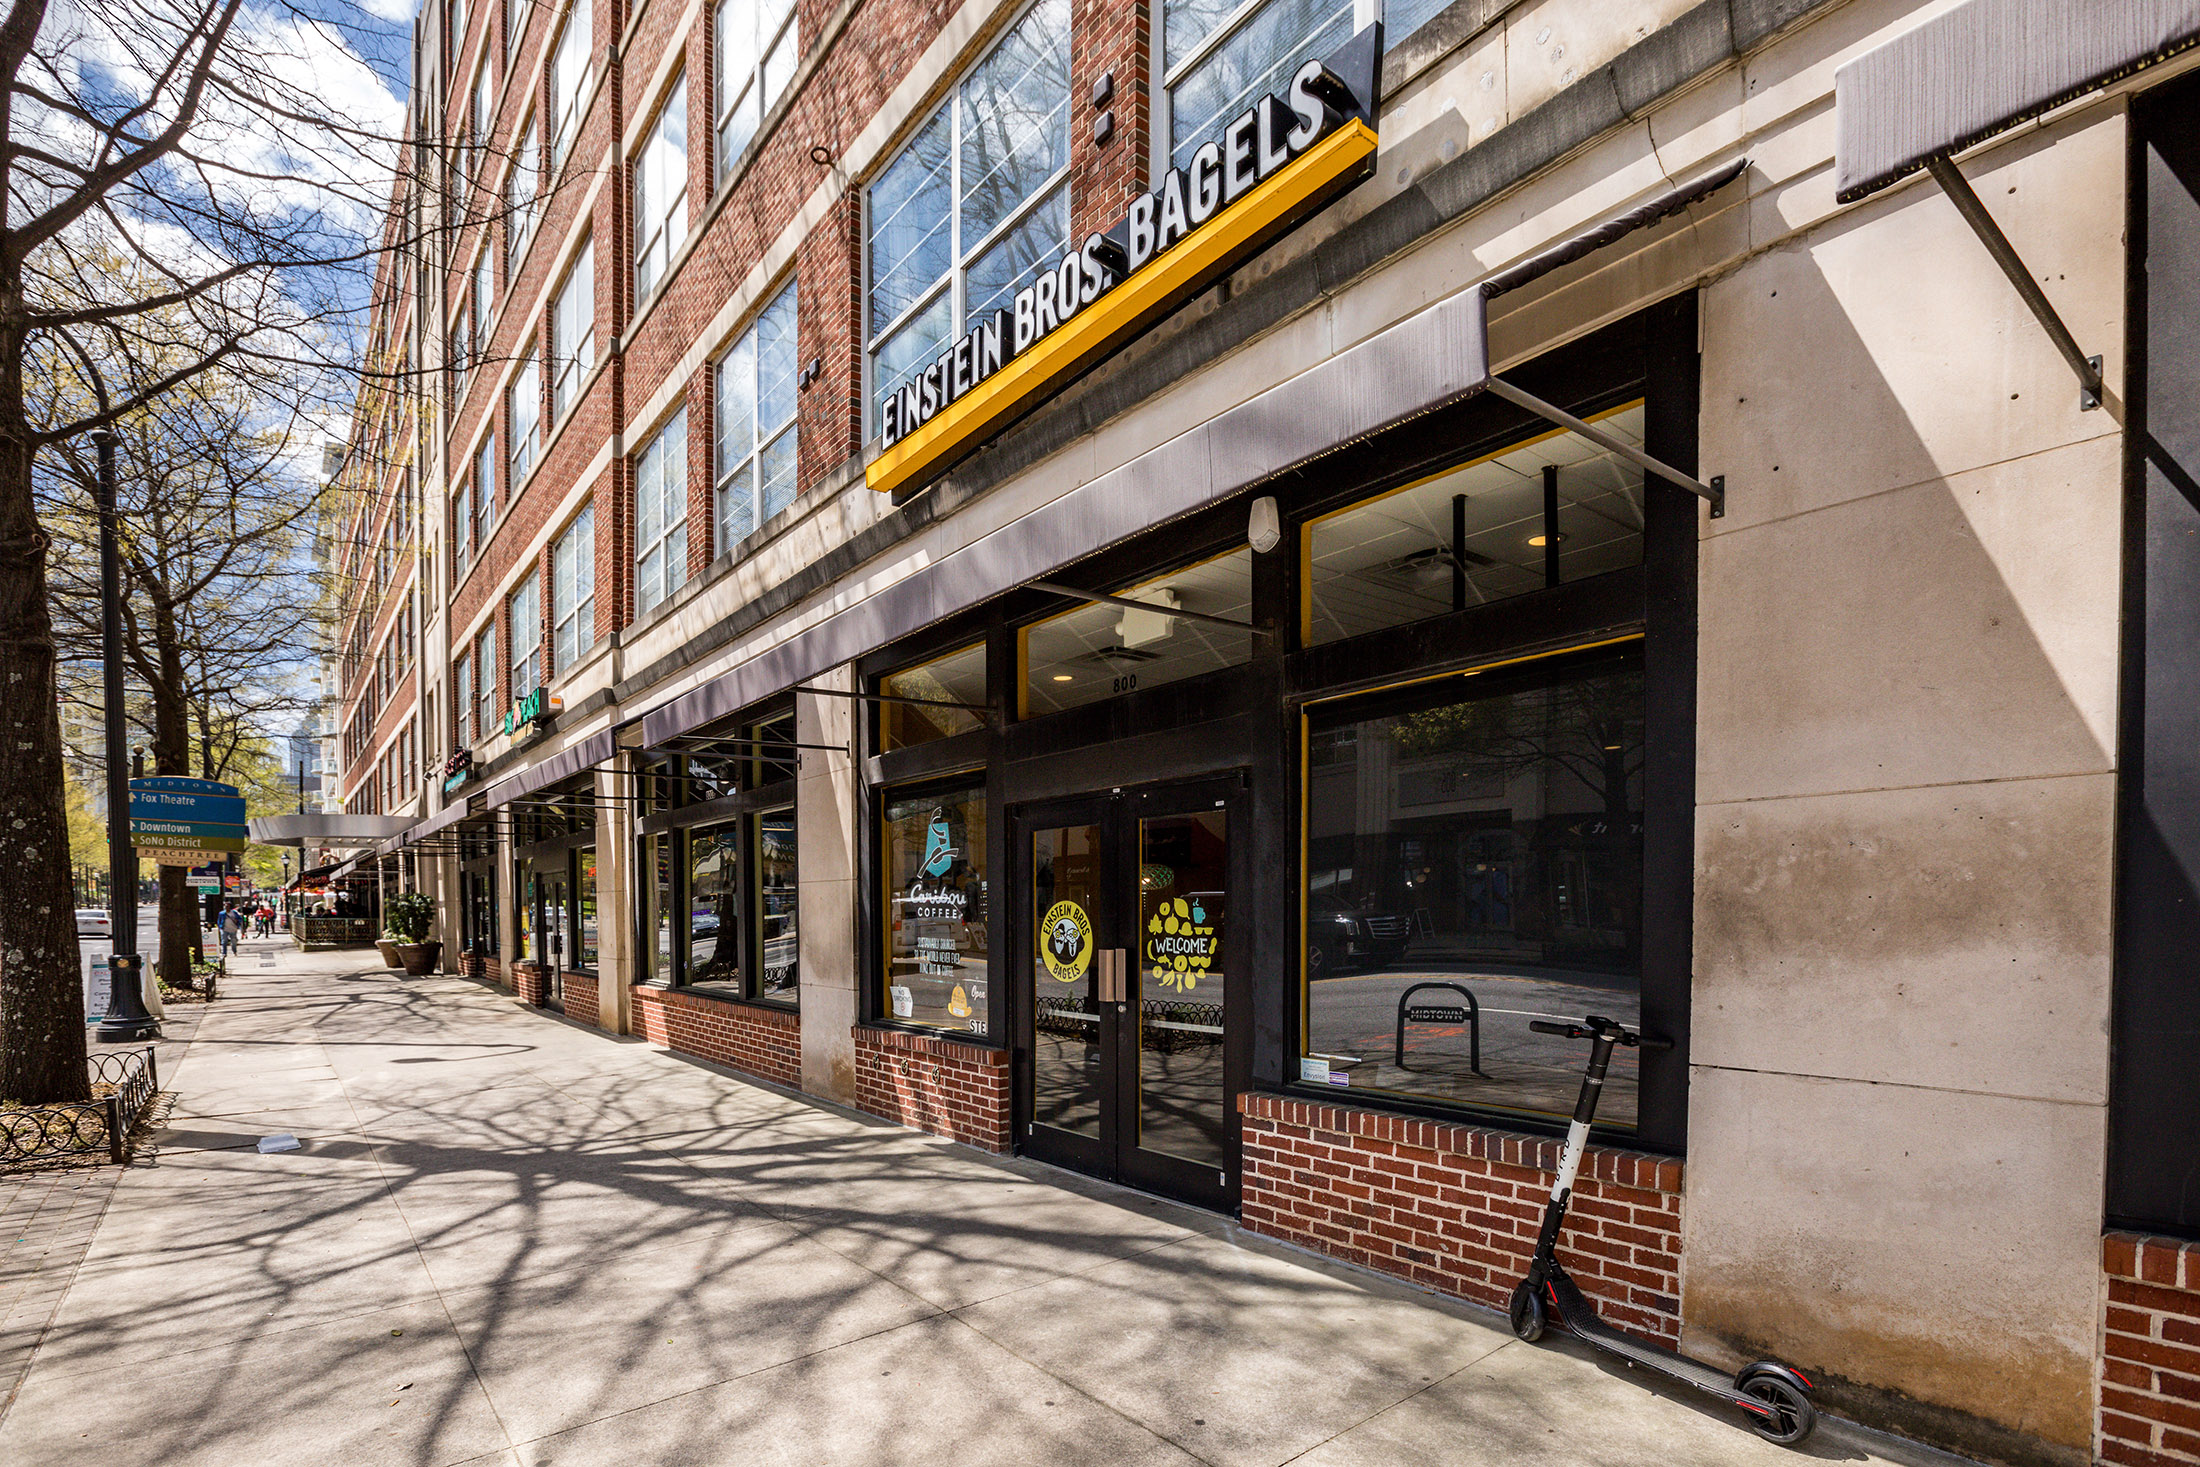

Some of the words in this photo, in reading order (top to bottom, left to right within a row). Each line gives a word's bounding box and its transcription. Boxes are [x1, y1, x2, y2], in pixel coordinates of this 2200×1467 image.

[881, 308, 1003, 451] EINSTEIN
[1013, 232, 1112, 356] BROS.
[1128, 59, 1325, 274] BAGELS
[1113, 674, 1136, 693] 800
[144, 781, 226, 792] MIDTOWN
[141, 793, 157, 803] Fox
[160, 794, 196, 806] Theatre
[140, 821, 191, 833] Downtown
[140, 835, 164, 846] SoNo
[167, 836, 201, 848] District
[145, 849, 219, 859] PEACHTREE
[910, 883, 967, 905] Caribou
[917, 907, 957, 919] COFFEE
[1043, 904, 1072, 935] EINSTEIN
[1073, 908, 1090, 936] BROS
[1155, 937, 1208, 954] WELCOME
[1053, 963, 1081, 979] BAGELS
[1410, 1009, 1463, 1020] MIDTOWN
[969, 1019, 986, 1033] STE
